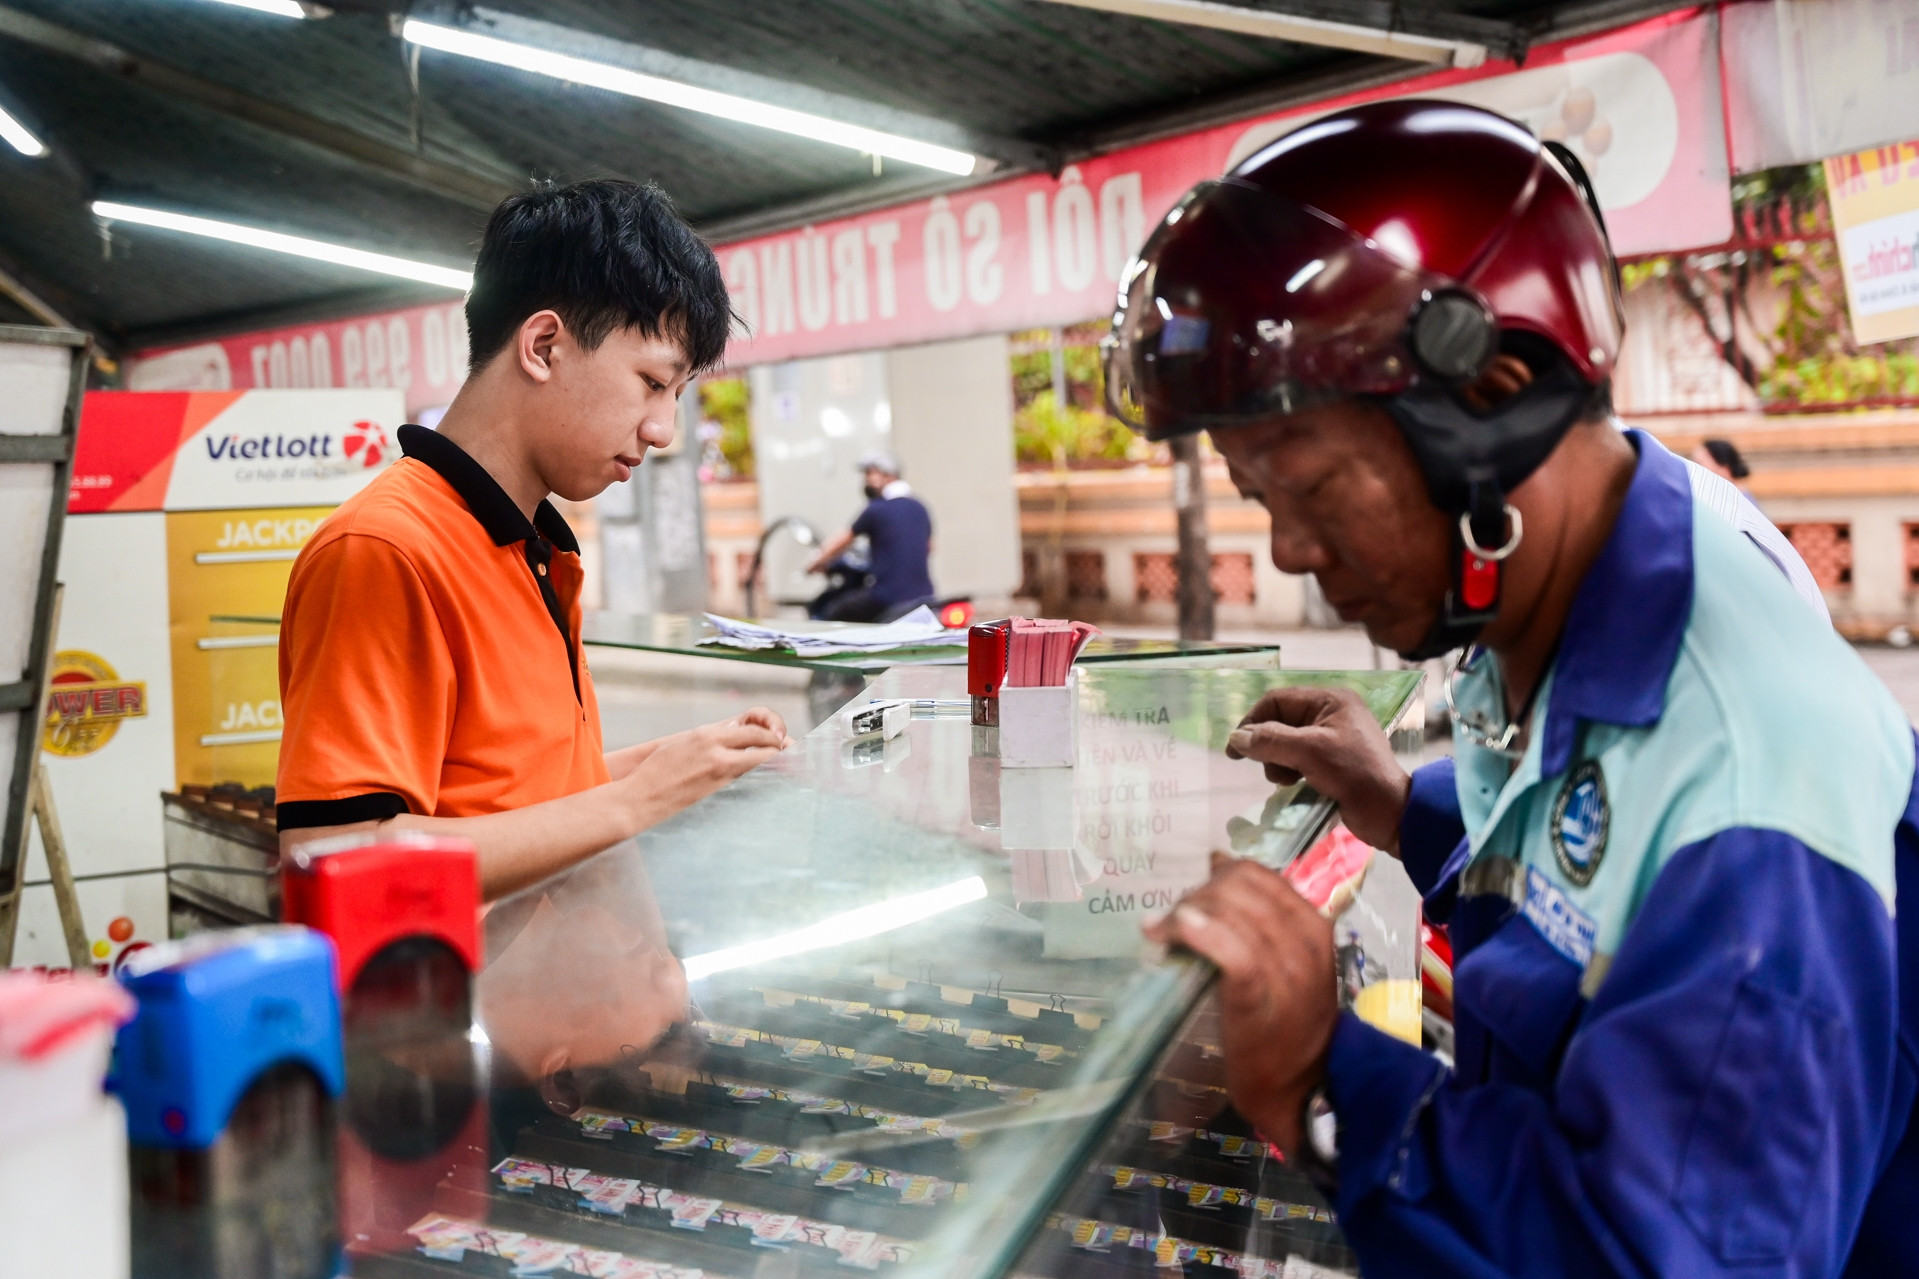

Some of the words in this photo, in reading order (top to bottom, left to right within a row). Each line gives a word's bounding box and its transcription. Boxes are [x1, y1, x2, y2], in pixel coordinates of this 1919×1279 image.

[206, 434, 331, 459] Vietlott
[217, 517, 325, 547] JACKP
[46, 686, 141, 719] WER
[221, 700, 284, 730] JAC
[1134, 706, 1171, 726] TRA
[1148, 778, 1179, 801] KHI
[1088, 888, 1135, 915] CẢM
[1141, 887, 1172, 909] ƠN
